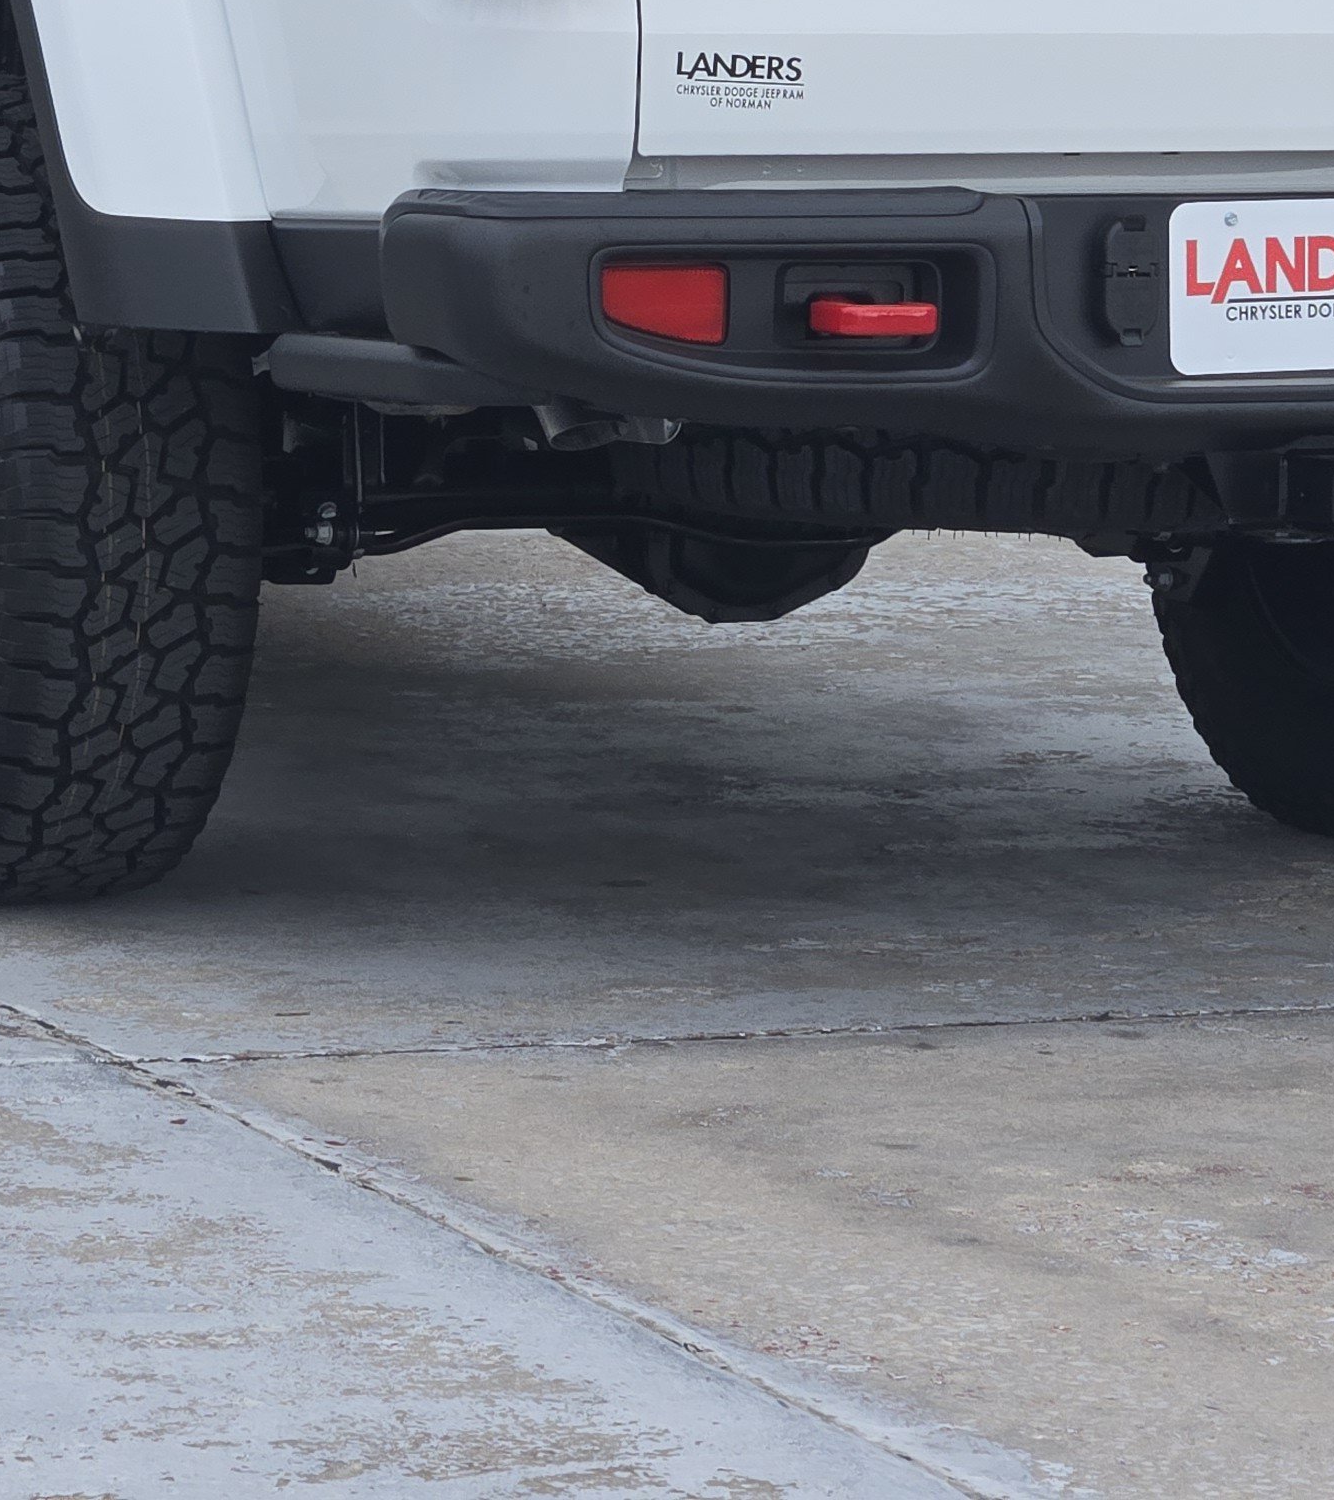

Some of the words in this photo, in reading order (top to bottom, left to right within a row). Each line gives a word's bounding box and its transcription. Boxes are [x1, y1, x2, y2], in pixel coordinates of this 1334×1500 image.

[676, 51, 802, 81] LANDERS
[676, 84, 721, 96] CHRYSLER
[724, 86, 758, 98] DODGE
[760, 88, 780, 99] JEEP
[782, 89, 804, 100] RAM
[710, 97, 723, 108] OF
[726, 97, 771, 110] NORMAN
[1225, 303, 1302, 322] CHRYSLER
